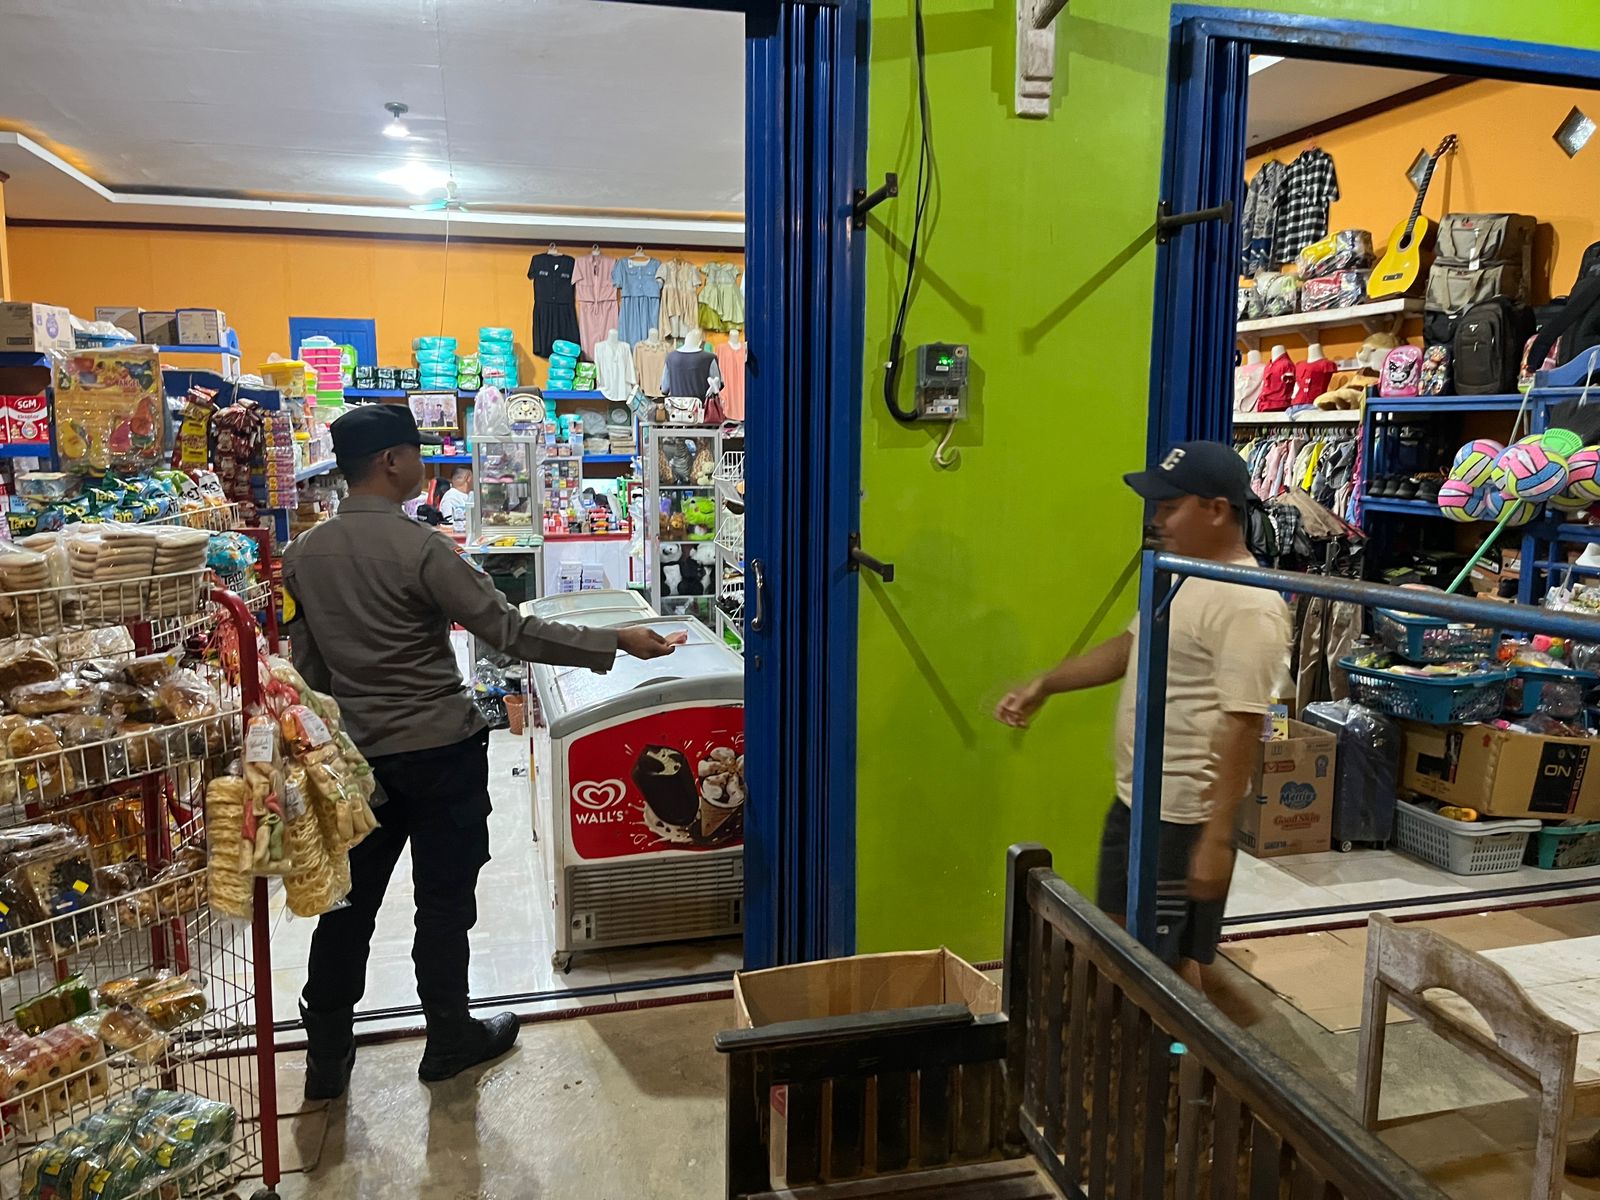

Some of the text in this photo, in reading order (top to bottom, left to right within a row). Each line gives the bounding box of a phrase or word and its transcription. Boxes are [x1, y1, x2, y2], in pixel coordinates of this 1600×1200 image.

[17, 399, 37, 410] SGM
[8, 516, 37, 530] Taro
[1544, 764, 1572, 778] ON
[1573, 748, 1588, 790] BOLD
[575, 810, 624, 824] WALL'S
